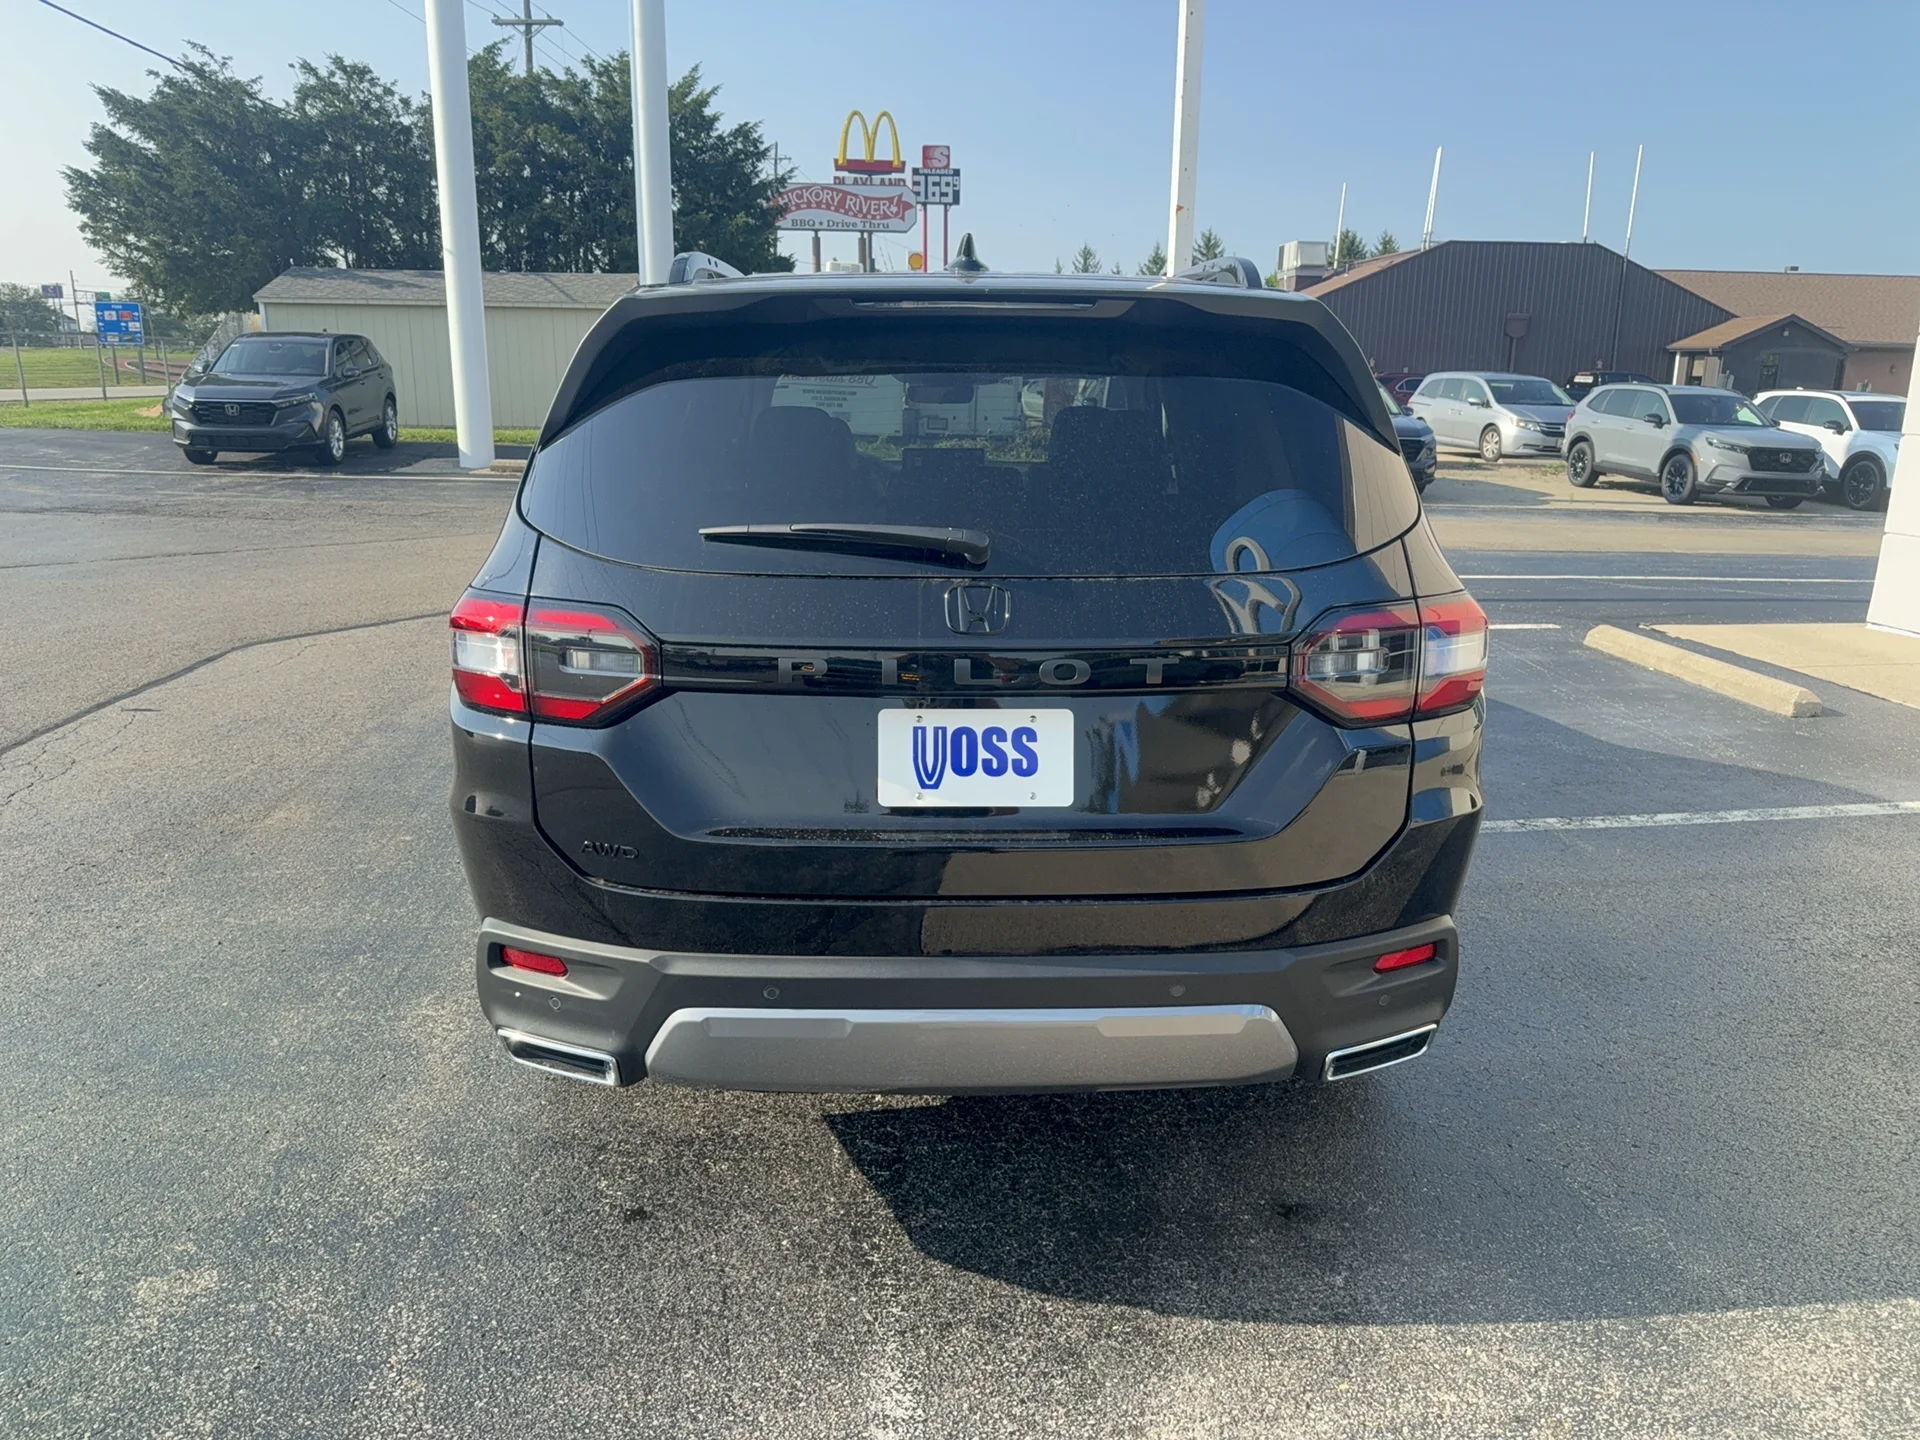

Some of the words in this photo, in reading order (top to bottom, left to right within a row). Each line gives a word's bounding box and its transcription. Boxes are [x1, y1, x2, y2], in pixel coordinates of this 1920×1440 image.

[778, 186, 842, 206] HICKORY
[790, 219, 816, 228] BBQ
[826, 219, 858, 229] Drive
[860, 220, 890, 230] Thru
[777, 657, 1181, 686] PILOT
[912, 725, 1039, 790] VOSS
[579, 840, 640, 859] AWD
